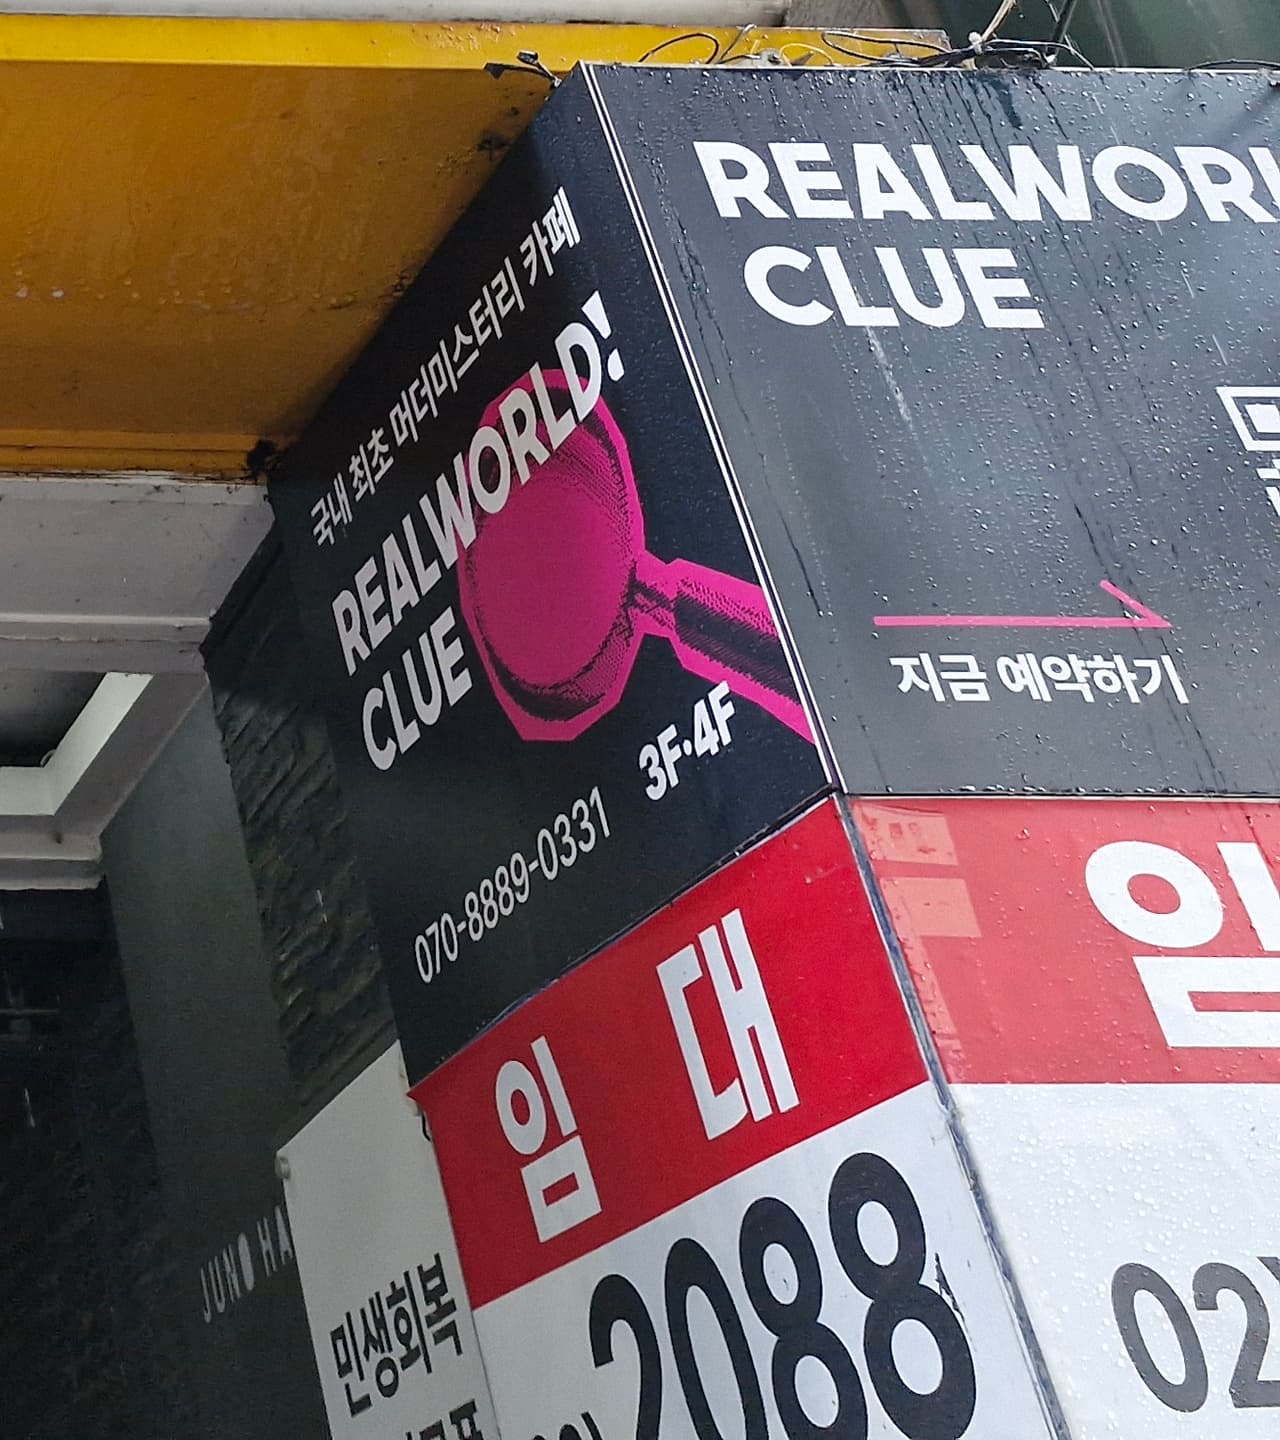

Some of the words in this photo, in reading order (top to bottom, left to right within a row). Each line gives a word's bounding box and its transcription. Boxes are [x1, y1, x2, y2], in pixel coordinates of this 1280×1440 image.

[310, 472, 353, 546] 국내
[348, 426, 394, 503] 최초
[389, 256, 526, 447] 머더미스터리
[519, 186, 582, 287] 카페
[743, 245, 1045, 329] CLUE
[332, 290, 625, 676] REALWORLD!
[362, 606, 473, 770] CLUE
[889, 655, 990, 702] 지금
[996, 653, 1189, 704] 예약하기
[414, 786, 611, 983] 070-8889-0331
[200, 1232, 255, 1324] JUNO
[329, 1252, 463, 1418] 민생회복
